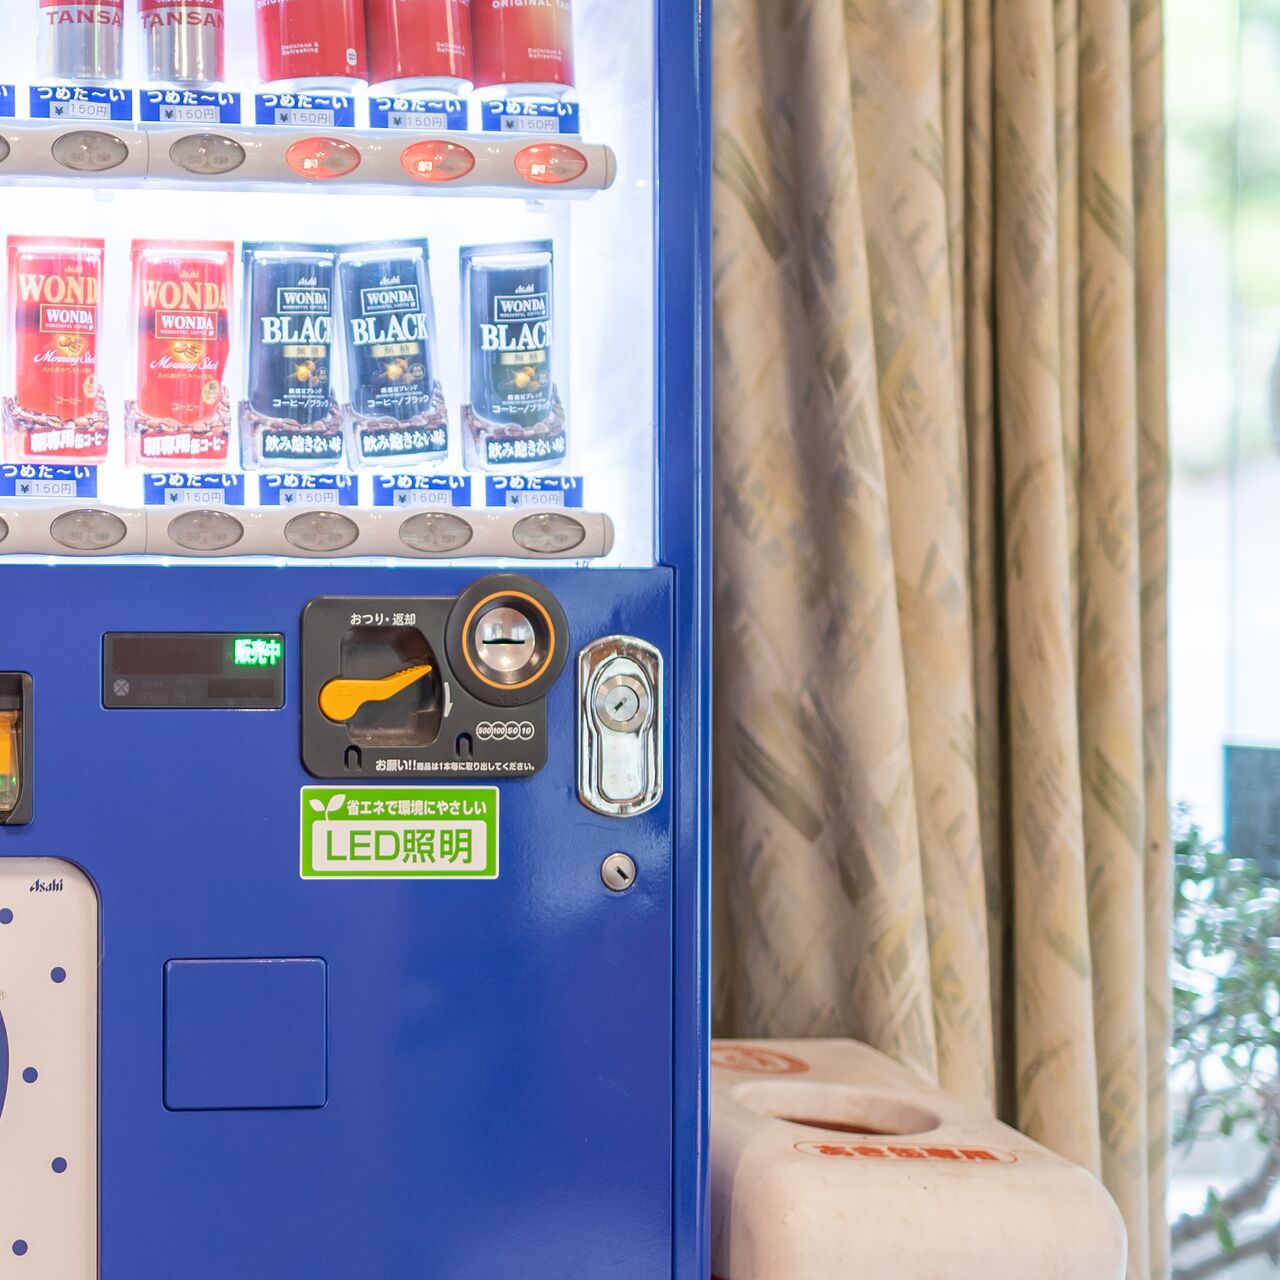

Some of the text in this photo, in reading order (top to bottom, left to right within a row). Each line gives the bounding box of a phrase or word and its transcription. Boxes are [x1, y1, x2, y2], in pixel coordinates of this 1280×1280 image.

[17, 273, 99, 303] WOND
[350, 313, 429, 345] BLACK
[33, 349, 82, 366] Morning
[149, 355, 197, 372] Morning
[54, 396, 83, 405] コーヒー
[171, 403, 200, 412] コーヒー
[265, 434, 342, 453] 飲み飽きない味
[363, 428, 446, 452] 飲み飽きない味
[487, 437, 566, 459] 飲み飽きない味
[350, 612, 416, 626] おつり・返却
[234, 639, 281, 665] 販売中
[506, 726, 519, 735] 50
[521, 726, 532, 735] 10
[346, 799, 487, 816] 省エネで環境にやさしい
[326, 828, 473, 864] LED照明
[29, 878, 64, 893] Asahi
